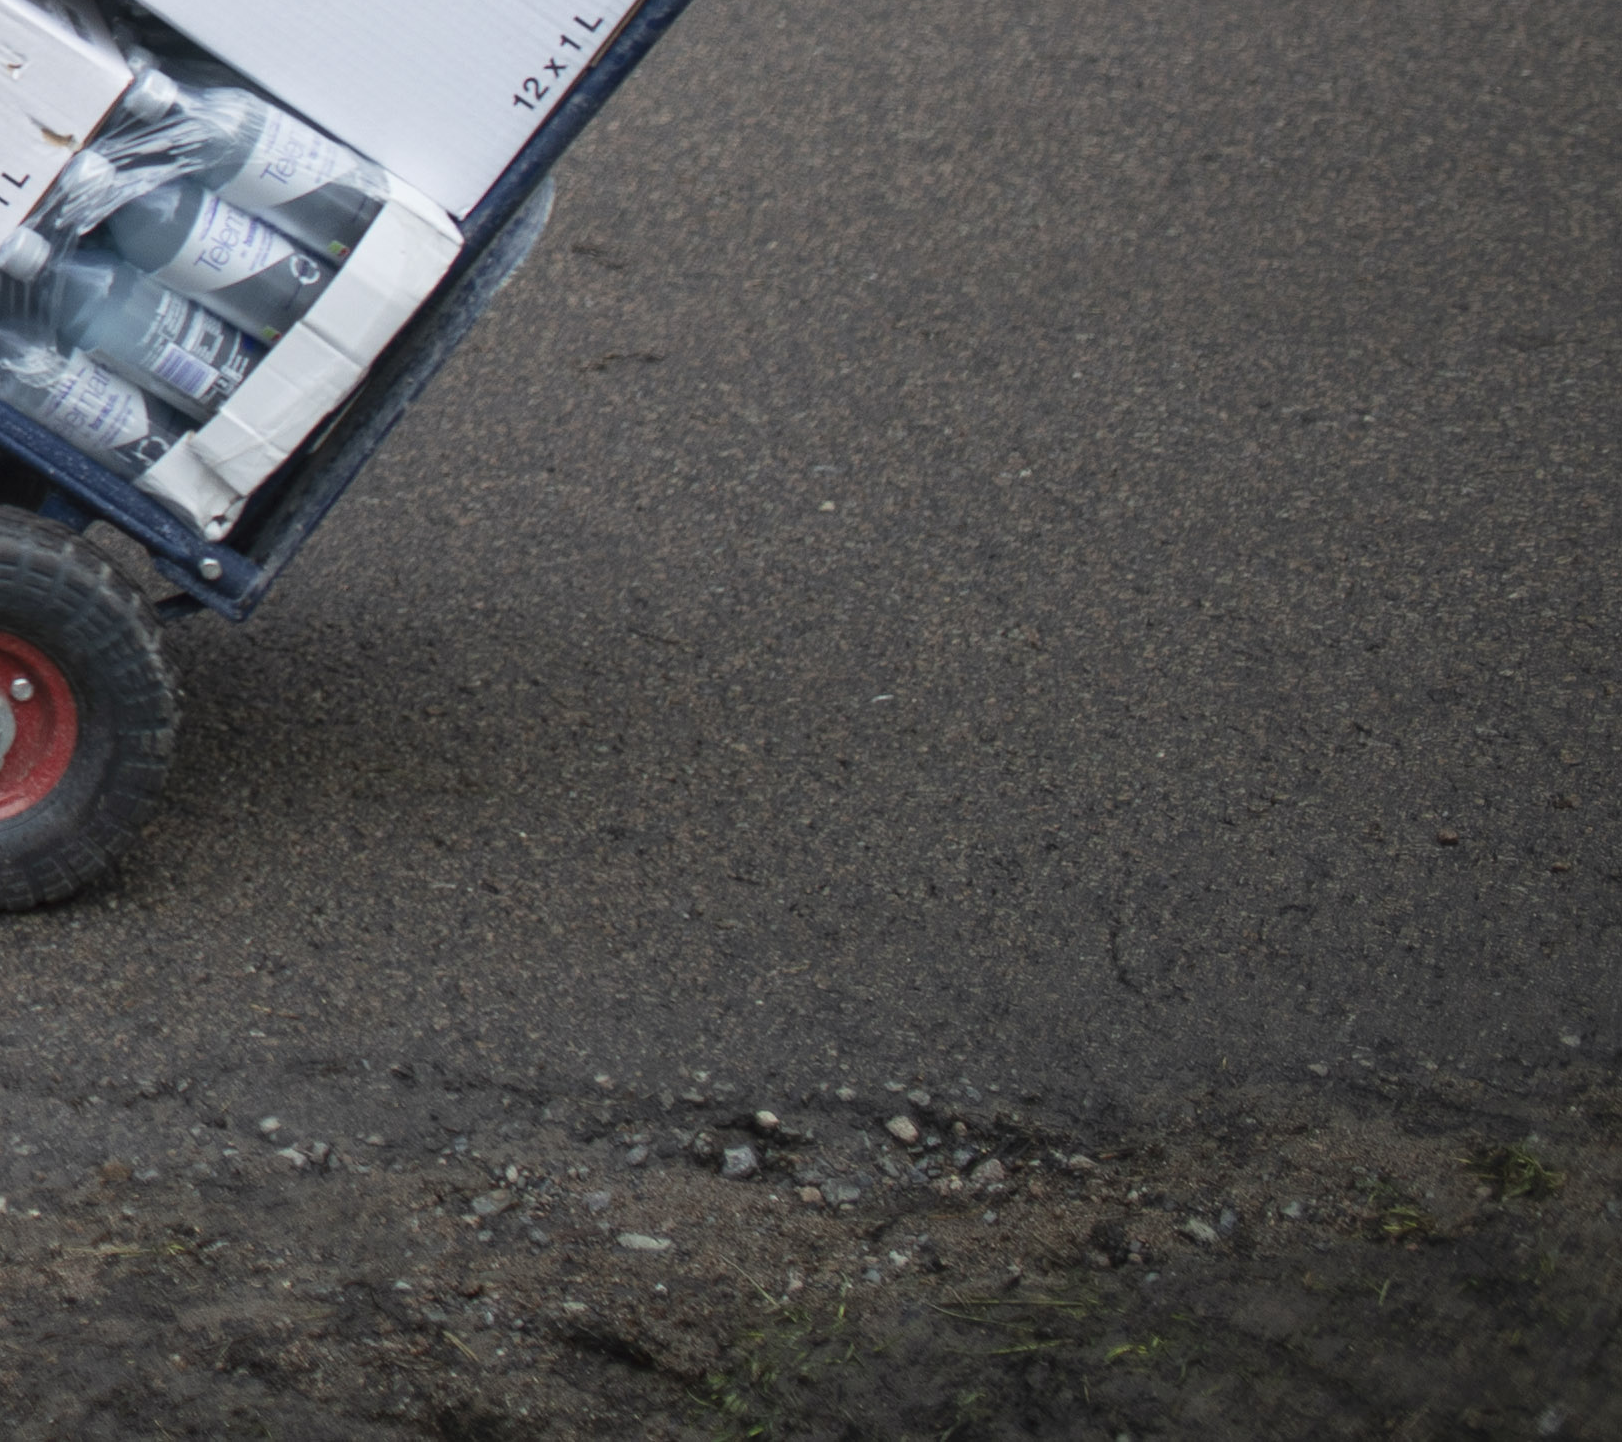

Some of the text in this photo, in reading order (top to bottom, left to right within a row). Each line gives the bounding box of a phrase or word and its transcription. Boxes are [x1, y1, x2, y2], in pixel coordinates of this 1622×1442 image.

[513, 16, 604, 110] 12 x 1 L
[0, 172, 31, 189] L
